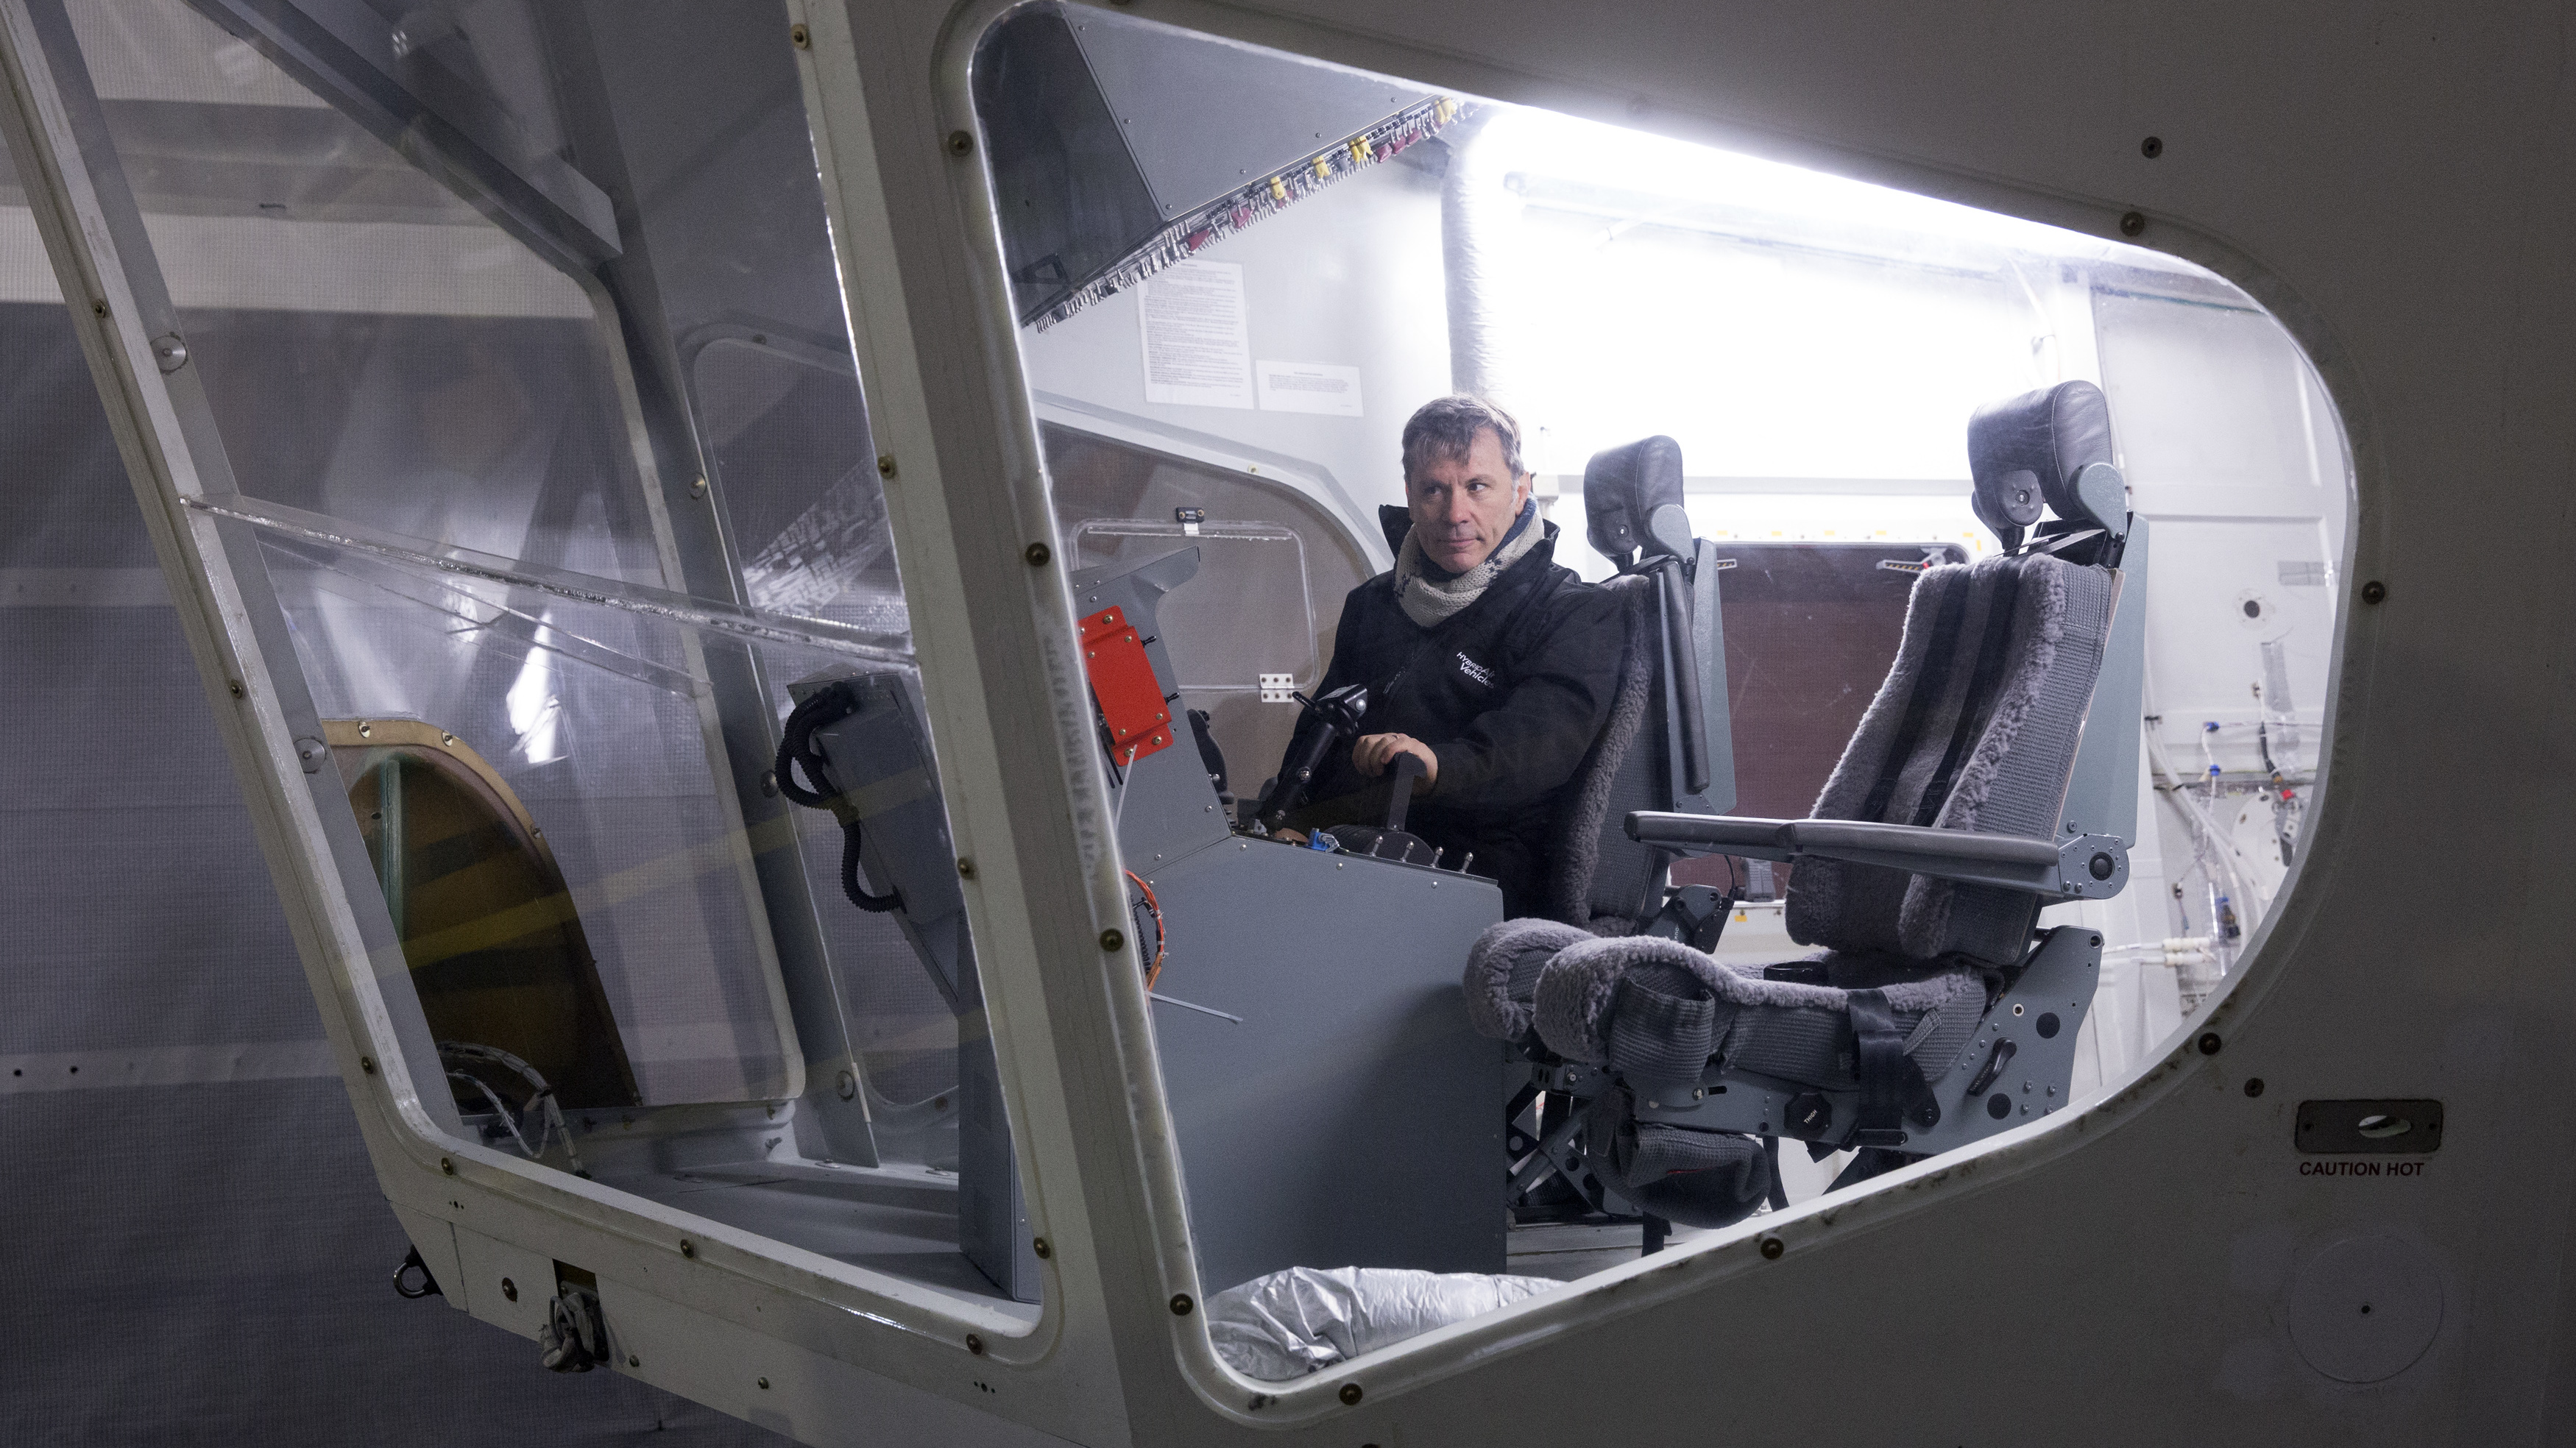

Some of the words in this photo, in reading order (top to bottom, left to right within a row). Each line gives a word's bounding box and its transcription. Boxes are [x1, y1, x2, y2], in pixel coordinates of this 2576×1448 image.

[1460, 662, 1494, 689] Vehicles
[1804, 1109, 1817, 1124] THIGH
[2299, 1162, 2380, 1176] CAUTION
[2387, 1163, 2424, 1176] HOT
